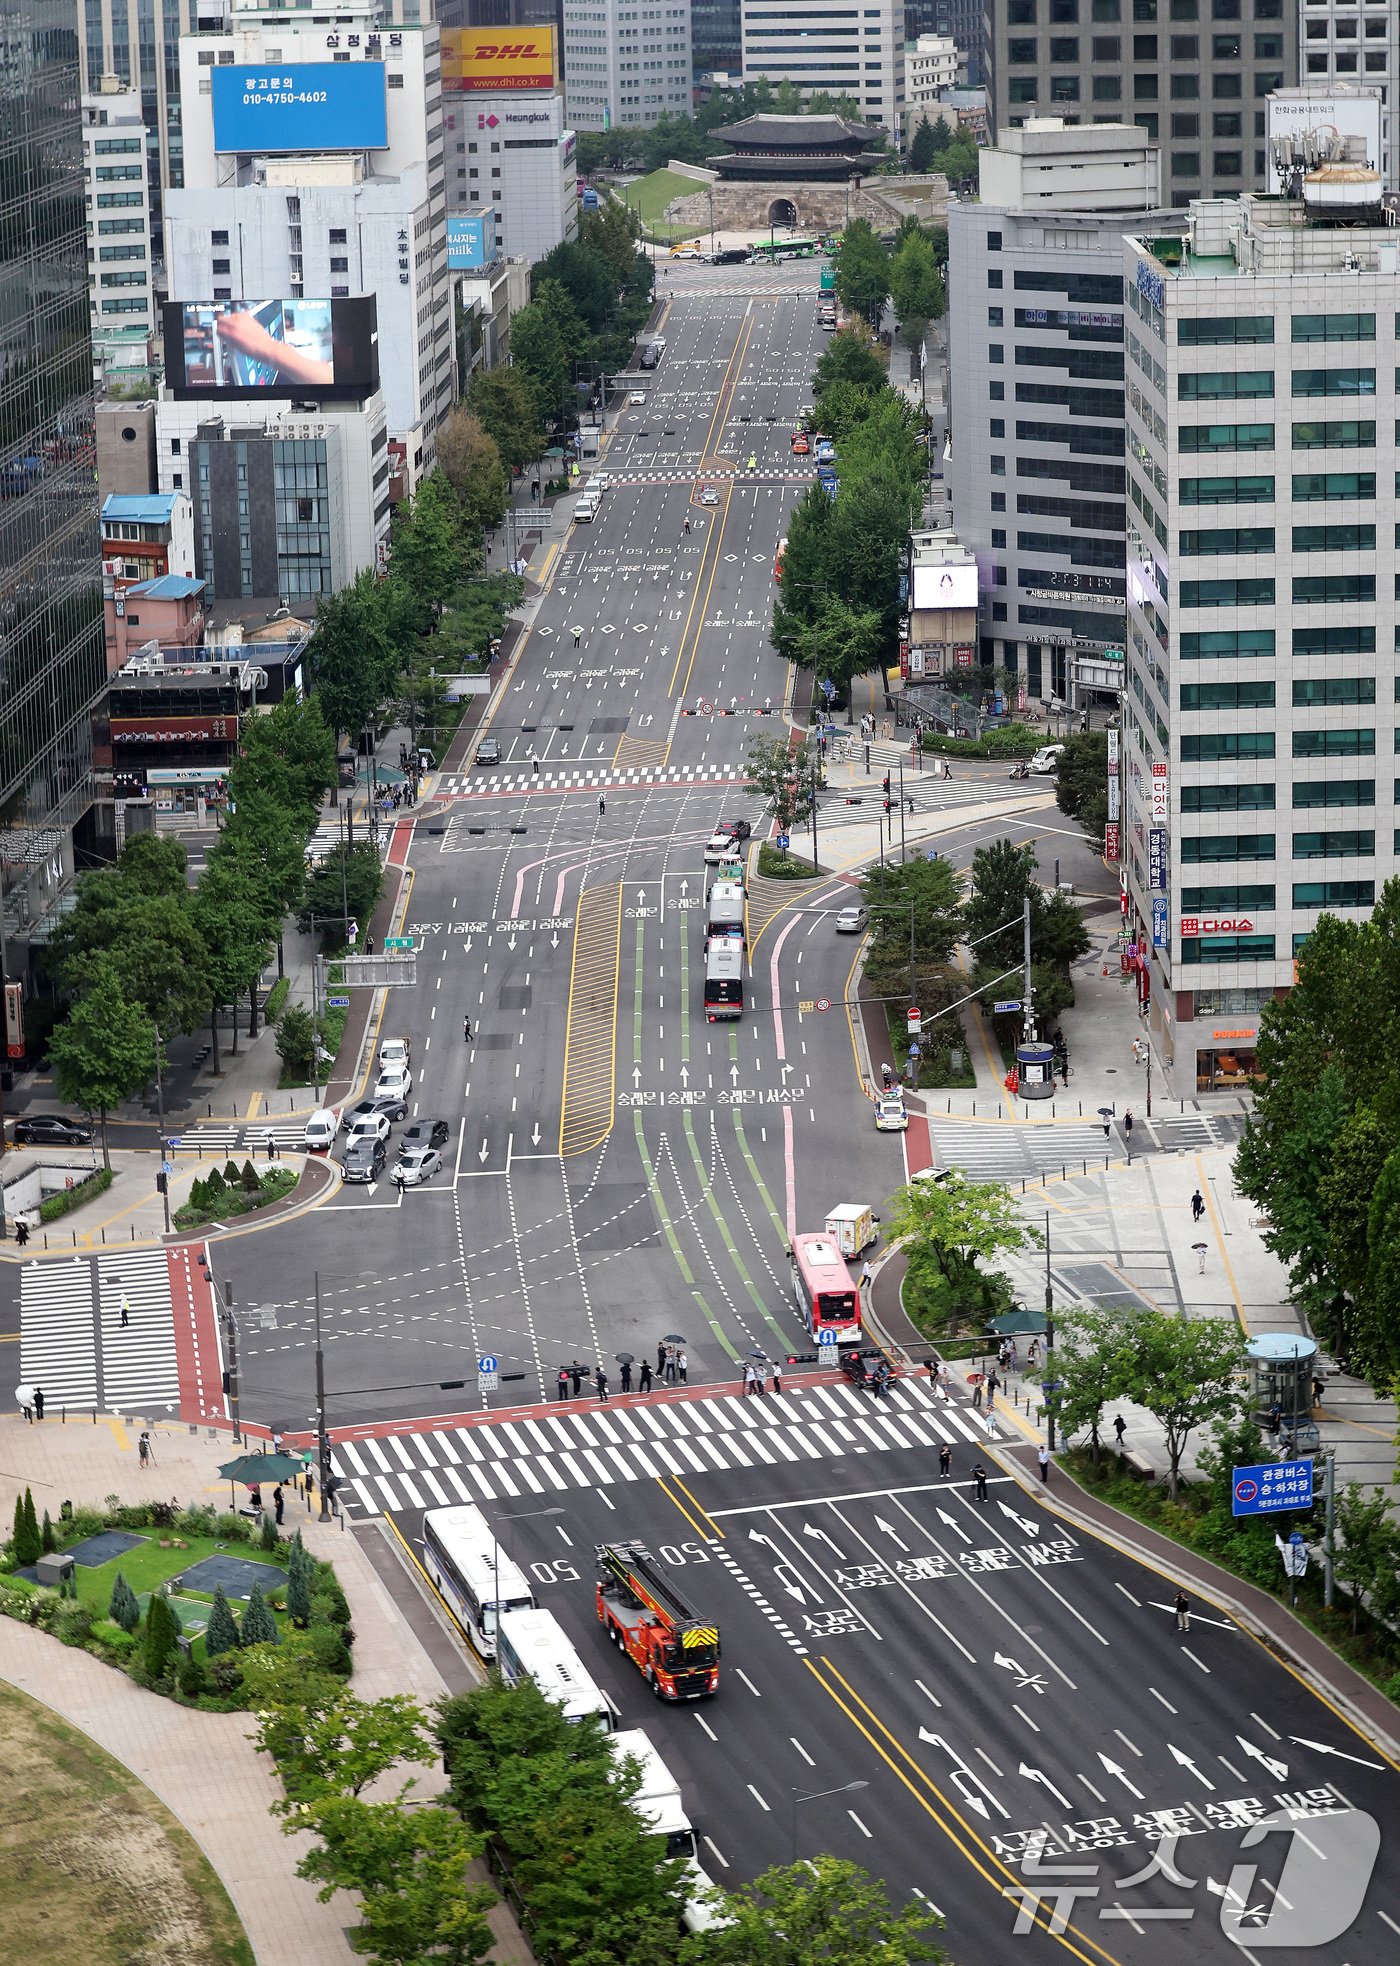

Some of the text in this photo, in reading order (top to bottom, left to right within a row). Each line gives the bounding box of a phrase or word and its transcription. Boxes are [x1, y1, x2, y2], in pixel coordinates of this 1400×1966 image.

[326, 34, 402, 48] 삼정빌딩
[474, 44, 540, 60] DHL
[246, 78, 293, 90] 광고문의
[473, 78, 540, 87] www.dhl.co.kr
[243, 92, 328, 105] 010-4750-4602
[506, 113, 550, 124] Heungkuk
[1154, 782, 1166, 815] 다이소
[1151, 834, 1161, 888] 경동대학교
[1202, 918, 1254, 934] 다이소
[766, 1088, 805, 1104] 서소문
[1262, 1466, 1308, 1481] 관광버스
[659, 1542, 711, 1566] 50
[530, 1560, 582, 1584] 50
[834, 1564, 896, 1590] 소공로
[1020, 1540, 1084, 1566] 서소문
[802, 1608, 865, 1638] 소공로
[991, 1829, 1072, 1864] 소공로
[1063, 1816, 1136, 1853] 소공로
[1273, 1788, 1350, 1821] 서소문
